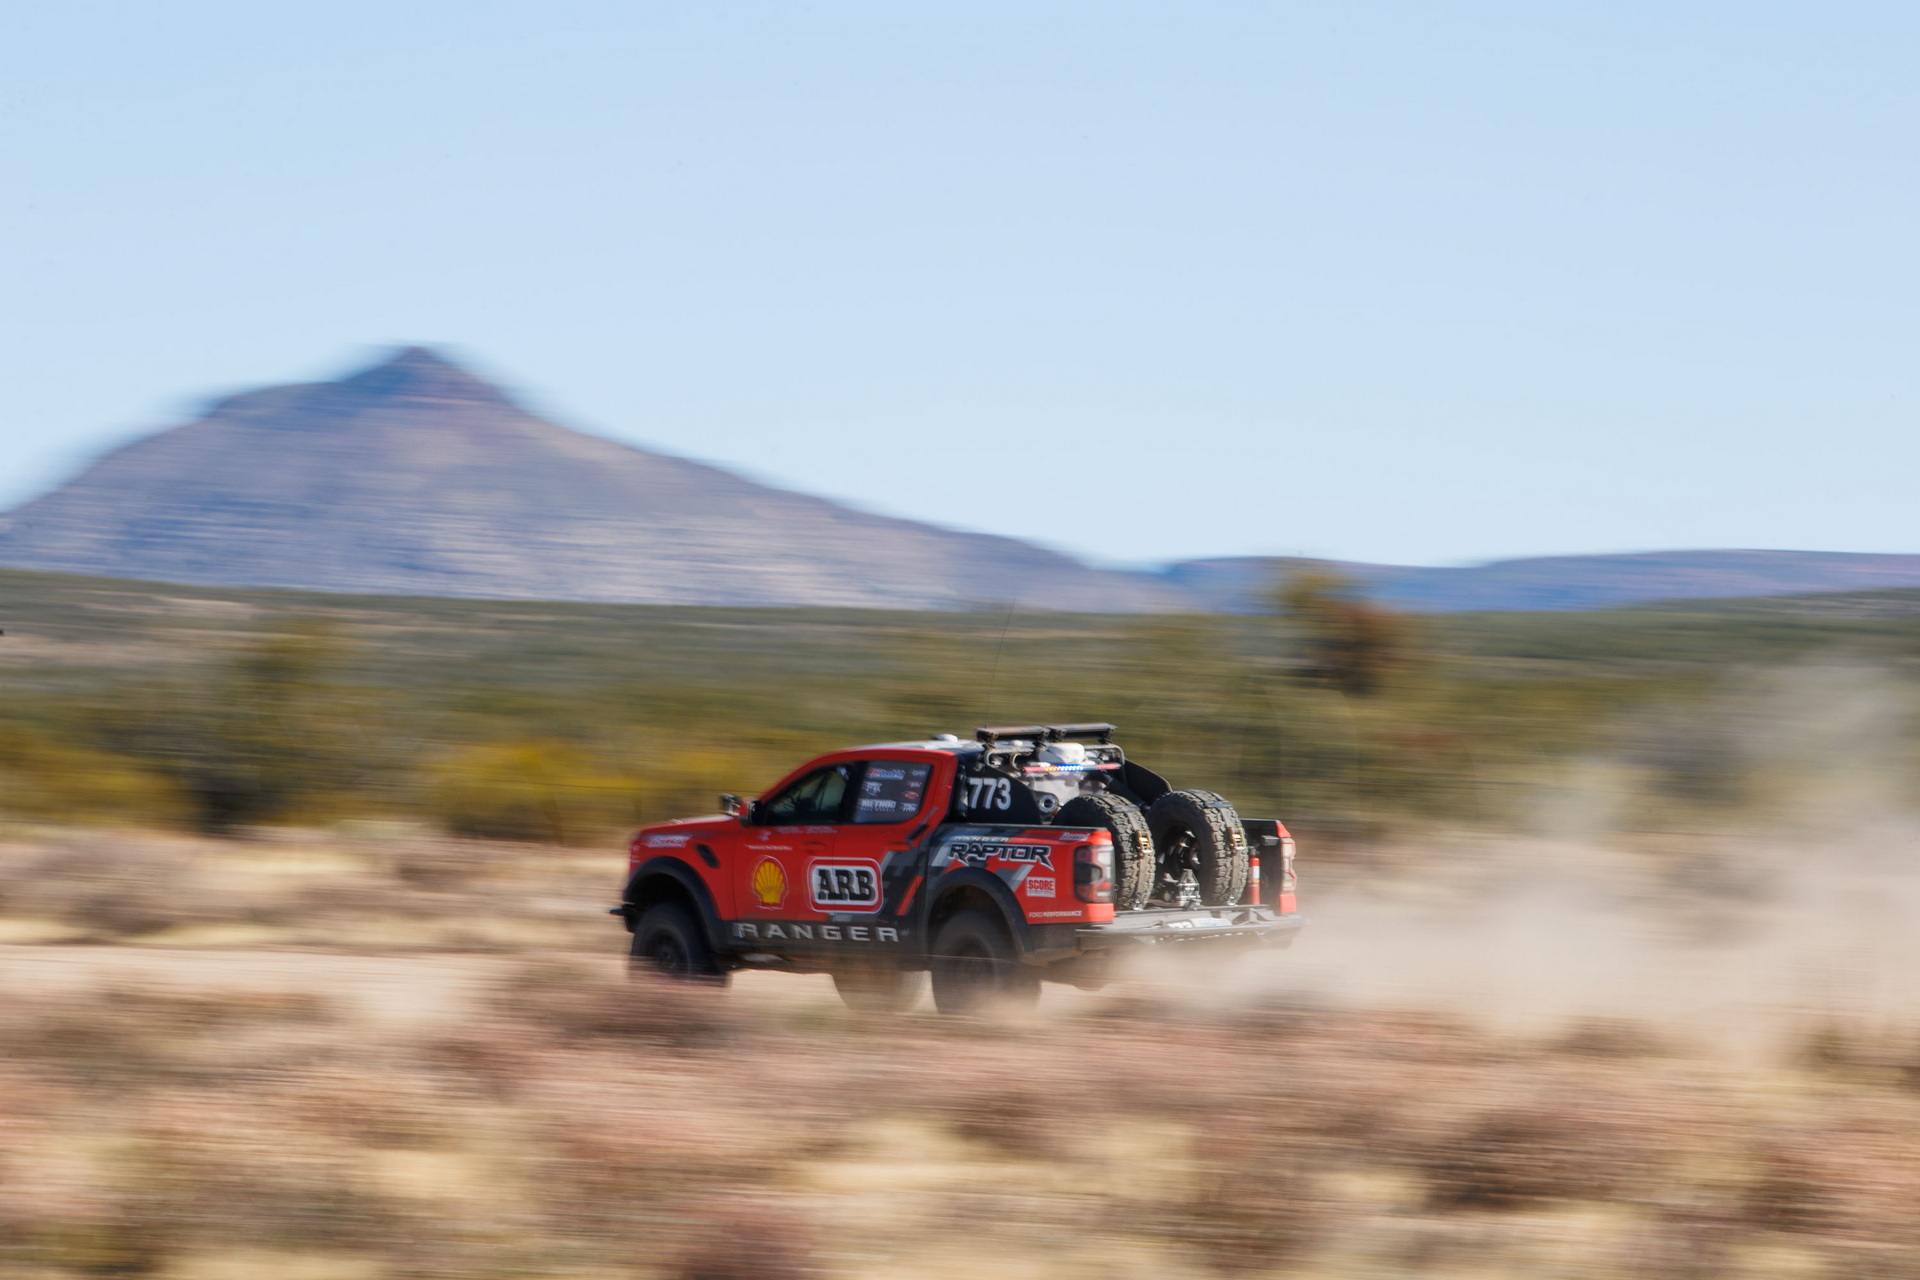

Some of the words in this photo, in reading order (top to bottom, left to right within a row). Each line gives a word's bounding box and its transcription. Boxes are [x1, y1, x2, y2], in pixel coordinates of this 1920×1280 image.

[969, 777, 1011, 810] 773
[948, 842, 1055, 872] RAPTOR
[817, 868, 877, 901] ARB
[1028, 879, 1055, 891] SCORE
[733, 922, 899, 943] RANGER
